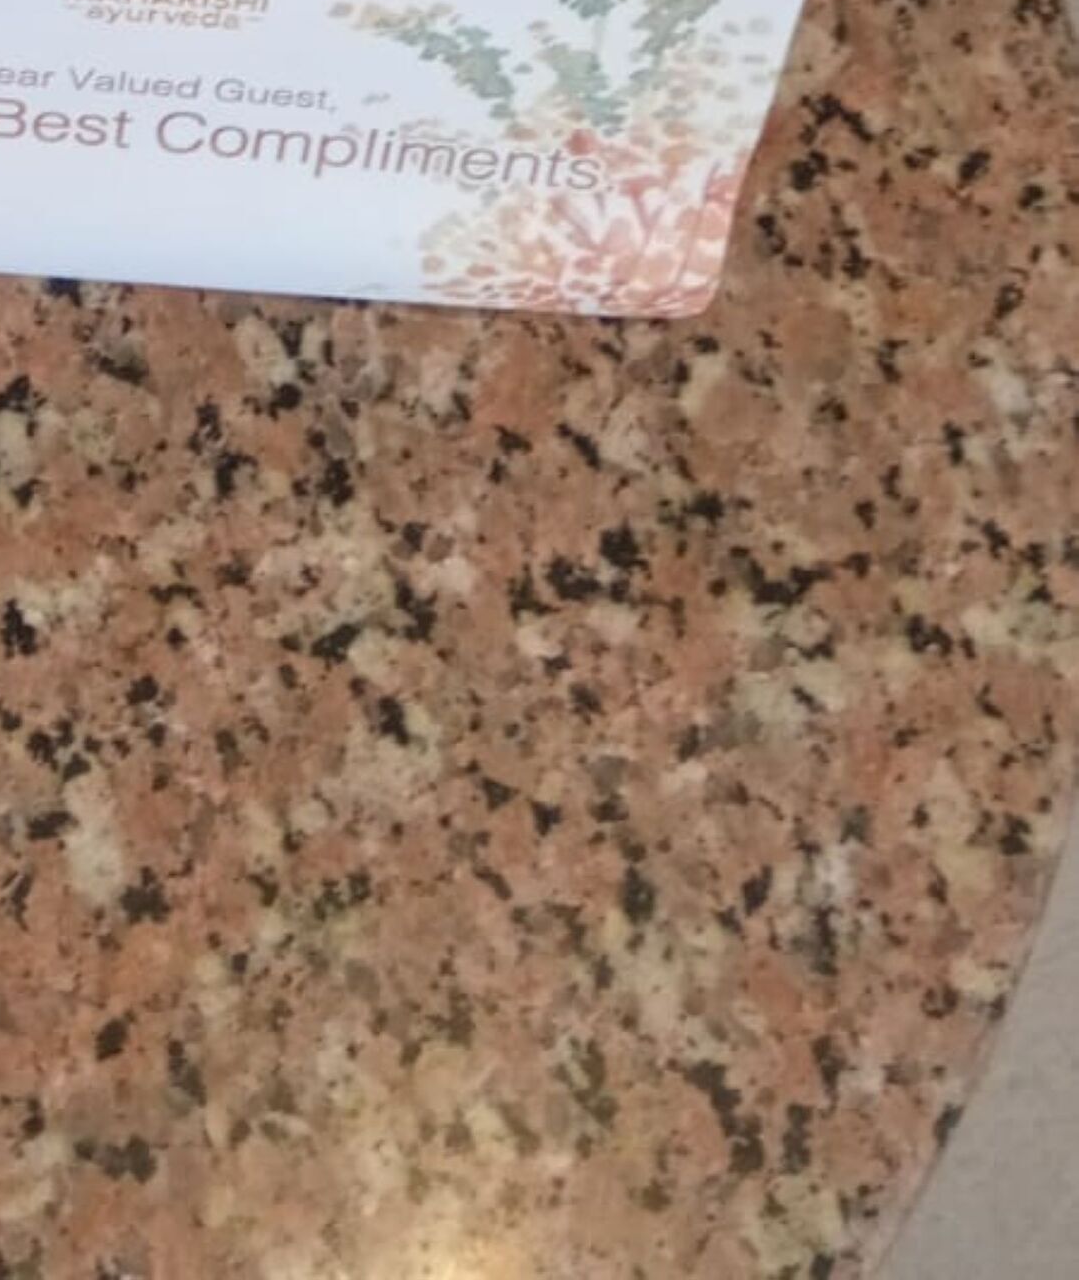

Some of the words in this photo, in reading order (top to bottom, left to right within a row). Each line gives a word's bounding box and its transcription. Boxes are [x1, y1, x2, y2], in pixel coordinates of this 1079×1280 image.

[86, 4, 241, 30] ayurveda
[68, 67, 202, 100] Valued
[214, 78, 338, 113] Guest,
